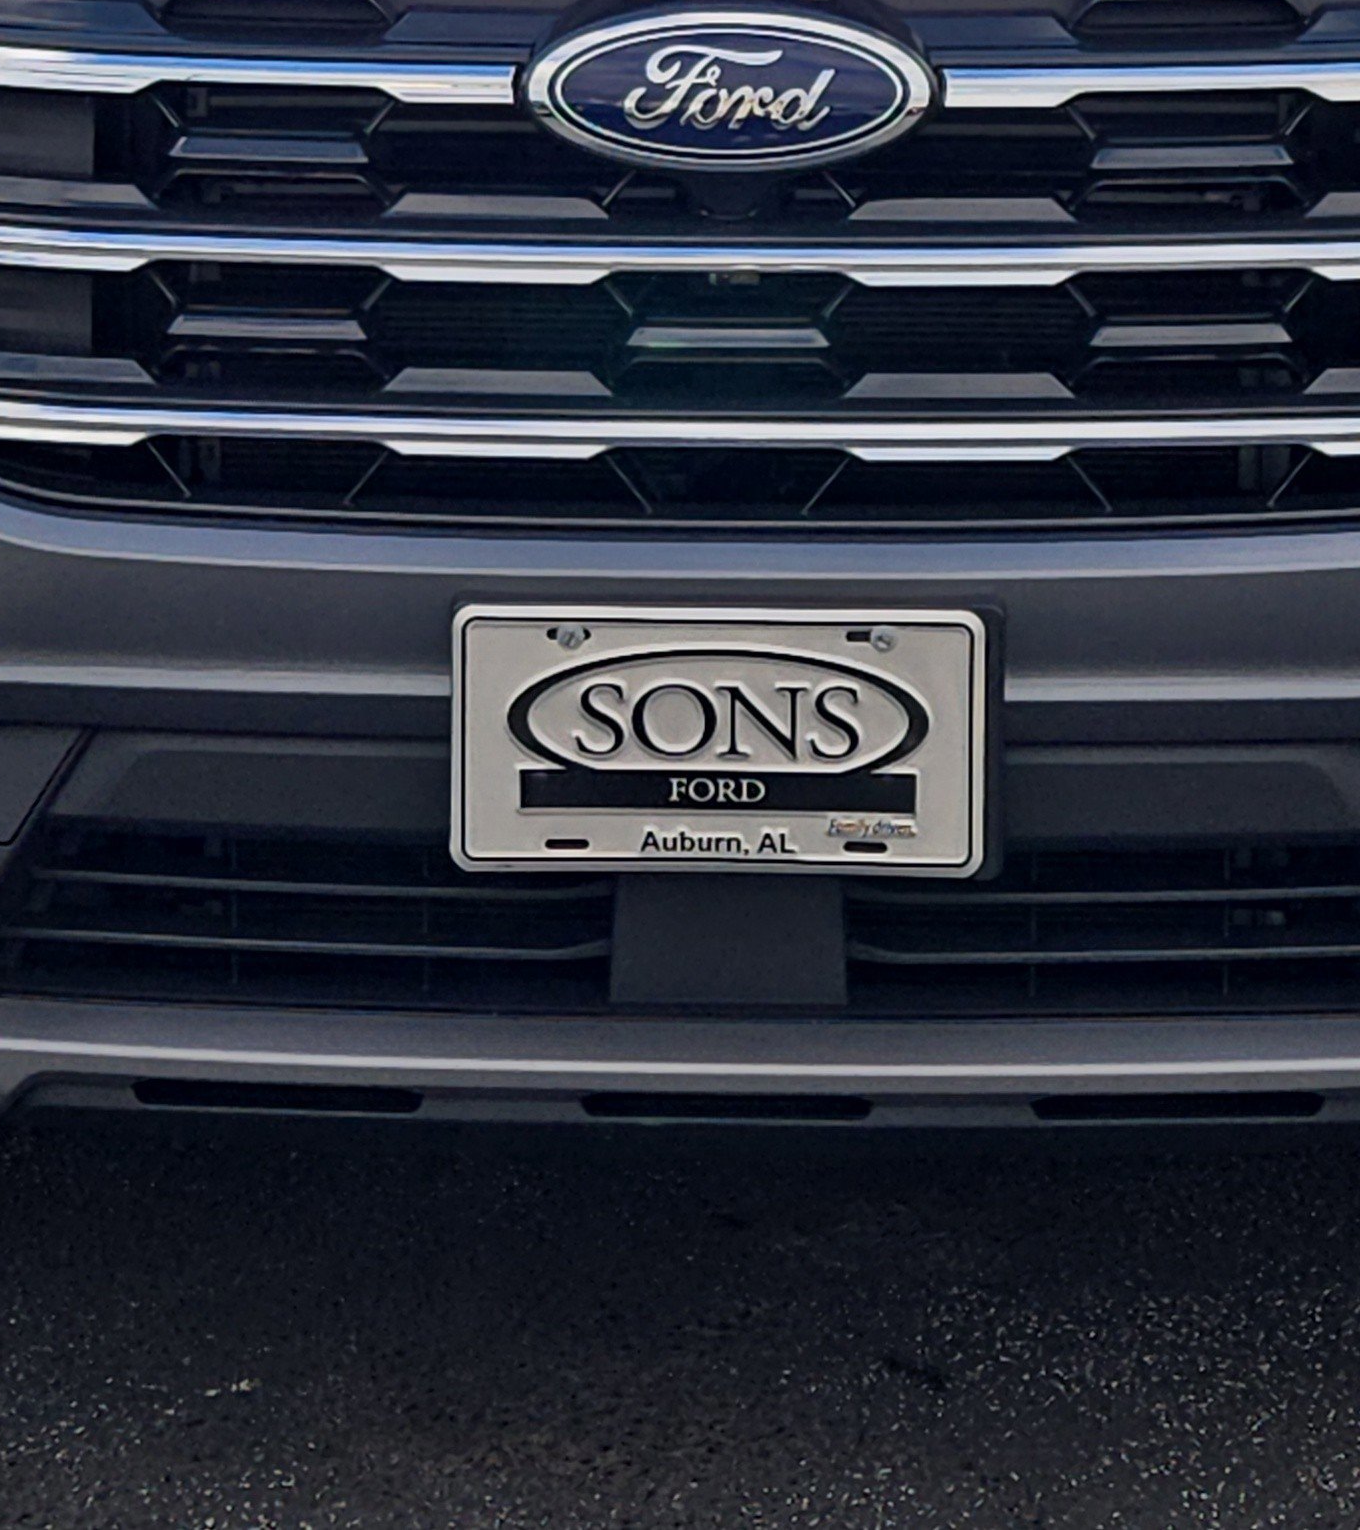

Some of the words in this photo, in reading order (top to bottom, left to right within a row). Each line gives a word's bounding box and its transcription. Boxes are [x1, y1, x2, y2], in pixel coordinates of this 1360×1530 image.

[624, 44, 837, 131] Ford
[574, 682, 860, 760] SONS
[668, 777, 766, 803] FORD
[641, 831, 750, 855] Auburn,
[757, 832, 797, 854] AL
